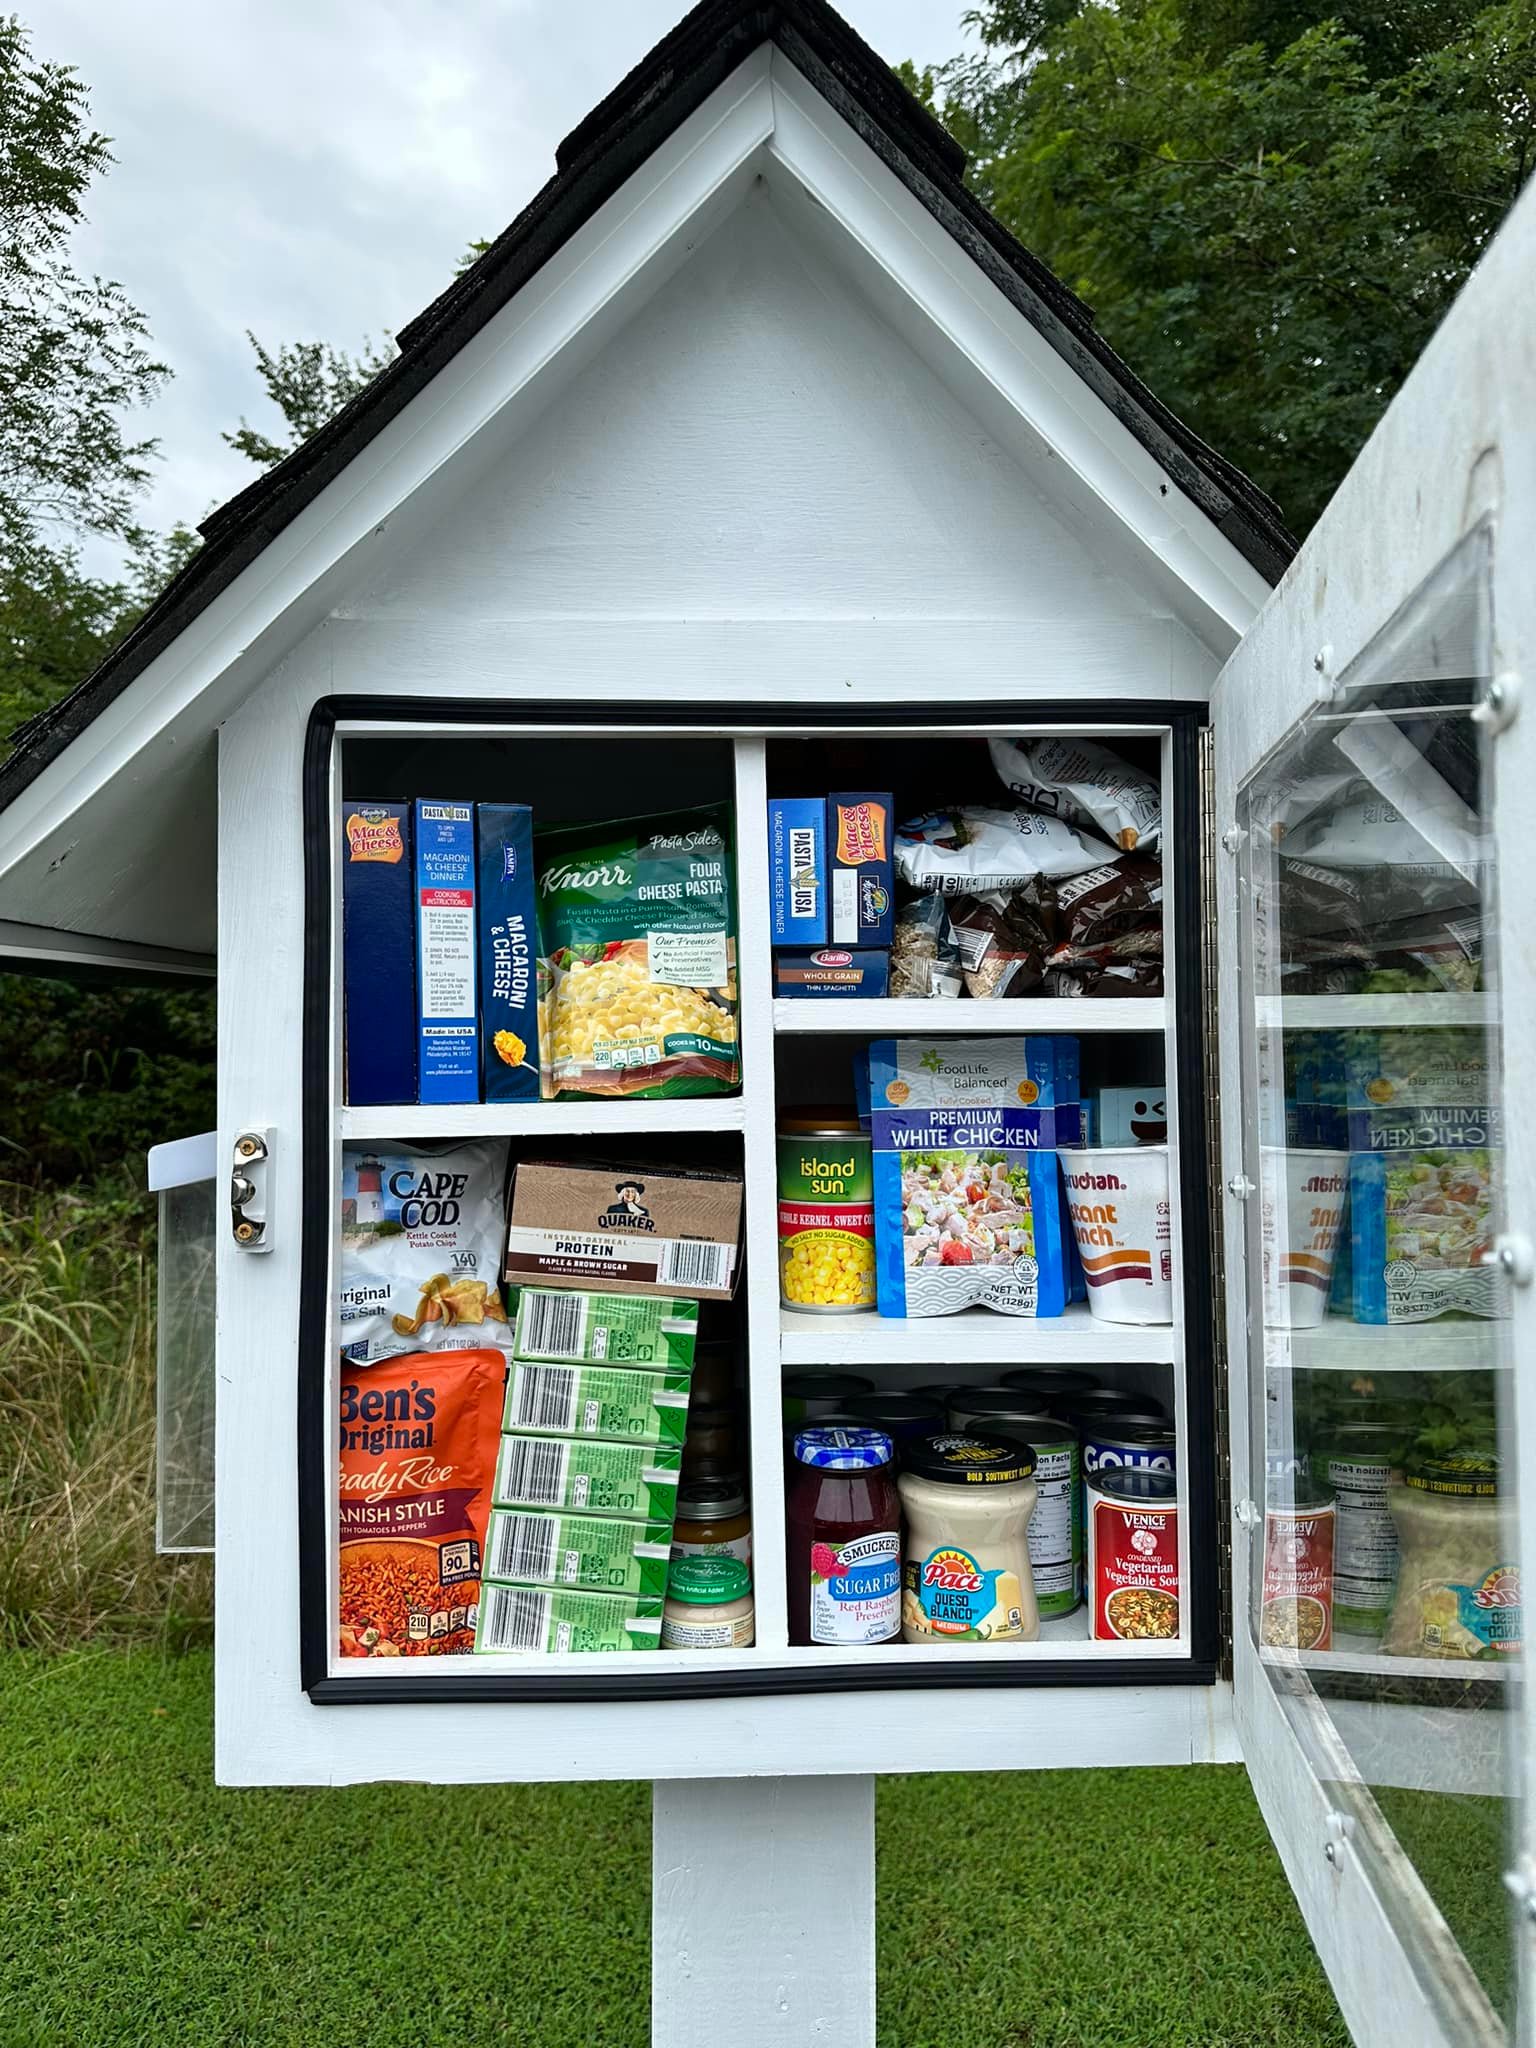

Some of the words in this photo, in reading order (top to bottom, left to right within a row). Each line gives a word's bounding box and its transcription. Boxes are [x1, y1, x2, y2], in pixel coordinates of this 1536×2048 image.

[424, 807, 444, 818] PASTA
[455, 808, 468, 819] USA
[843, 807, 857, 822] &
[352, 825, 382, 840] Mac
[385, 825, 398, 838] &
[774, 811, 784, 856] MACARONI
[857, 804, 878, 862] Cheese
[351, 837, 401, 854] Cheese
[649, 834, 683, 850] Pasta
[682, 830, 720, 851] Sides
[846, 827, 857, 860] Mac
[794, 832, 811, 868] PASTA
[423, 853, 471, 863] MACARONI
[506, 847, 514, 875] PAMPA
[425, 863, 433, 871] &
[434, 863, 468, 872] CHEESE
[690, 862, 722, 879] FOUR
[430, 872, 464, 881] DINNER
[538, 863, 632, 899] Knorr
[776, 866, 784, 900] CHEESE
[434, 891, 460, 899] COOKING
[638, 883, 683, 901] CHEESE
[685, 879, 723, 897] PASTA
[795, 890, 812, 914] USA
[567, 908, 592, 916] Fusilli
[593, 906, 619, 915] Pasta
[584, 914, 623, 924] Cheddar
[625, 912, 658, 921] Cheese
[658, 909, 699, 920] Flavored
[776, 901, 785, 935] DINNER
[490, 926, 505, 936] &
[672, 922, 702, 930] Natural
[703, 921, 726, 929] Flavor
[655, 936, 674, 946] Our
[676, 937, 717, 946] Promise
[506, 915, 529, 1009] MACARONI
[820, 953, 850, 963] Barilla
[493, 938, 511, 1000] CHEESE
[803, 971, 833, 980] WHOLE
[834, 971, 860, 980] GRAIN
[668, 1040, 689, 1048] COOKS
[696, 1038, 711, 1051] 10
[595, 1052, 609, 1062] 220
[937, 1064, 966, 1074] Food
[968, 1064, 989, 1074] Life
[954, 1076, 1008, 1089] Balanced
[939, 1097, 957, 1106] Fully
[959, 1097, 992, 1106] Cooked
[930, 1111, 1002, 1126] PREMIUM
[891, 1130, 948, 1146] WHITE
[953, 1127, 1039, 1146] CHICKEN
[801, 1158, 855, 1177] island
[389, 1170, 468, 1200] CAPE
[812, 1179, 844, 1194] sun
[1065, 1172, 1120, 1190] ruchan
[401, 1200, 460, 1229] COD
[799, 1213, 833, 1226] KERNEL
[834, 1214, 862, 1226] SWEET
[598, 1213, 655, 1233] QUAKER
[406, 1231, 429, 1240] Kettle
[430, 1231, 457, 1239] Cooked
[543, 1233, 583, 1242] INSTANT
[585, 1236, 628, 1246] OATMEAL
[799, 1232, 812, 1241] SALT
[813, 1231, 824, 1239] NO
[825, 1231, 846, 1240] SUGAR
[847, 1235, 865, 1248] ADDED
[409, 1240, 434, 1248] Potato
[436, 1239, 457, 1248] Chips
[555, 1242, 614, 1257] PROTEIN
[450, 1253, 477, 1267] 140
[539, 1257, 565, 1266] MAPLE
[573, 1259, 601, 1268] BROWN
[602, 1263, 628, 1271] SUGAR
[340, 1284, 391, 1305] riginal
[991, 1284, 1012, 1294] NET
[1018, 1286, 1034, 1295] WT
[983, 1293, 1000, 1304] OZ
[1001, 1297, 1034, 1309] (128g)
[341, 1312, 356, 1321] ea
[359, 1306, 386, 1318] Salt
[340, 1379, 436, 1423] Ben's
[1051, 1454, 1070, 1464] Facts
[340, 1461, 398, 1504] eady
[397, 1456, 454, 1490] Rice
[966, 1471, 983, 1482] BOLD
[985, 1470, 1018, 1482] SOUTHWEST
[1060, 1482, 1071, 1494] 90
[340, 1508, 391, 1523] ANISH
[395, 1499, 446, 1521] STYLE
[353, 1526, 390, 1534] TOMATOES
[398, 1522, 427, 1532] PEPPERS
[1122, 1512, 1166, 1529] VENICE
[446, 1556, 463, 1572] 90
[1127, 1553, 1162, 1563] CONDENSED
[1115, 1557, 1174, 1576] Vegetarian
[924, 1564, 984, 1592] Pace
[1104, 1567, 1157, 1587] Vegetable
[1159, 1575, 1179, 1587] Sou
[686, 1586, 707, 1594] Artificial
[707, 1586, 725, 1594] Added
[835, 1577, 881, 1595] SUGAR
[840, 1601, 861, 1612] Red
[935, 1592, 969, 1607] QUESO
[855, 1607, 895, 1622] Preserves
[930, 1604, 973, 1621] BLANCO
[1011, 1610, 1018, 1619] 45
[410, 1616, 427, 1627] 210
[936, 1620, 967, 1631] MEDIUM
